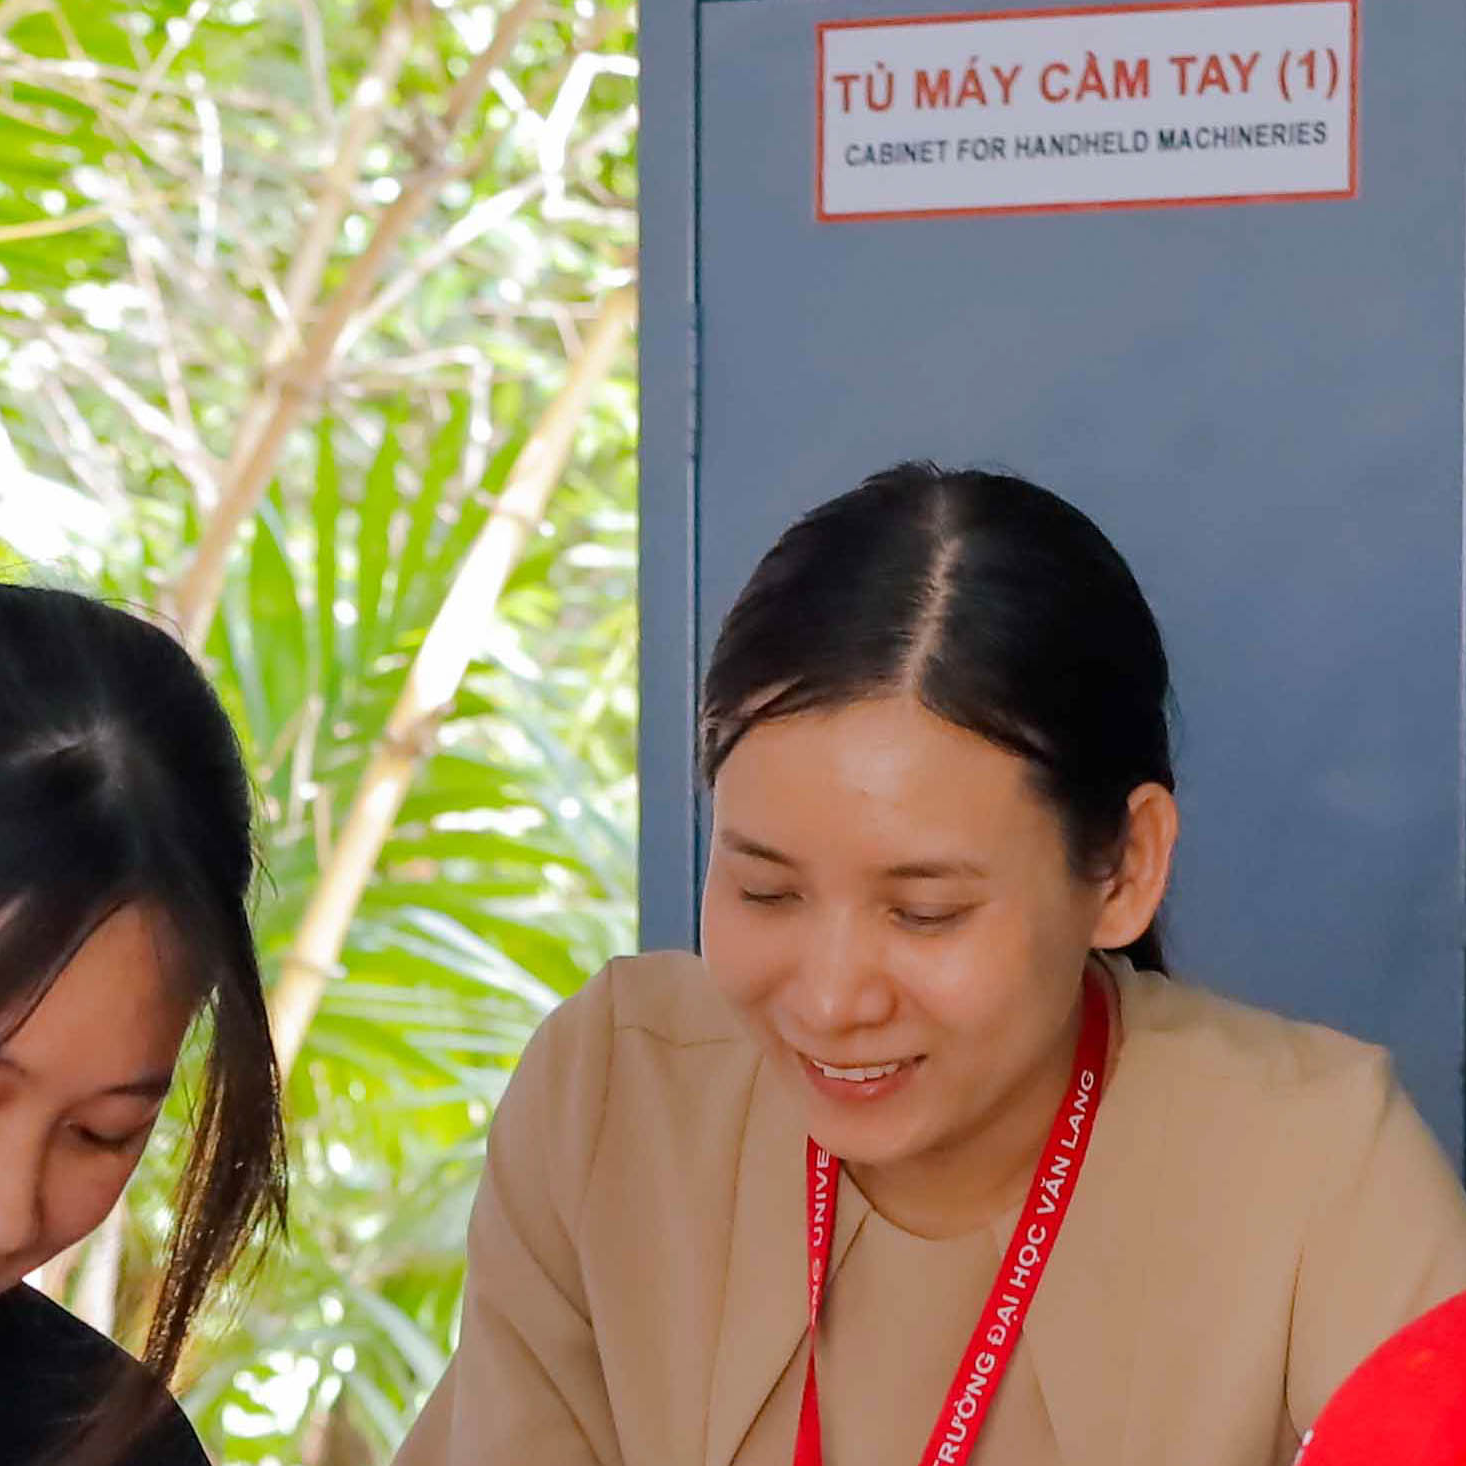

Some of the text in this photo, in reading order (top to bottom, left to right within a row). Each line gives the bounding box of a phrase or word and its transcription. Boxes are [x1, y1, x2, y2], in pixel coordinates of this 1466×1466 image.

[914, 55, 1022, 110] MÁY
[1169, 51, 1261, 96] TAY
[1277, 48, 1339, 103] (1)
[844, 121, 1327, 167] CABINET FOR HANDHELD MACHINERIES
[986, 1294, 1020, 1346] ĐẠI
[1009, 1223, 1046, 1289] HỌC
[1036, 1155, 1071, 1214] VĂN
[1060, 1069, 1095, 1150] LANG
